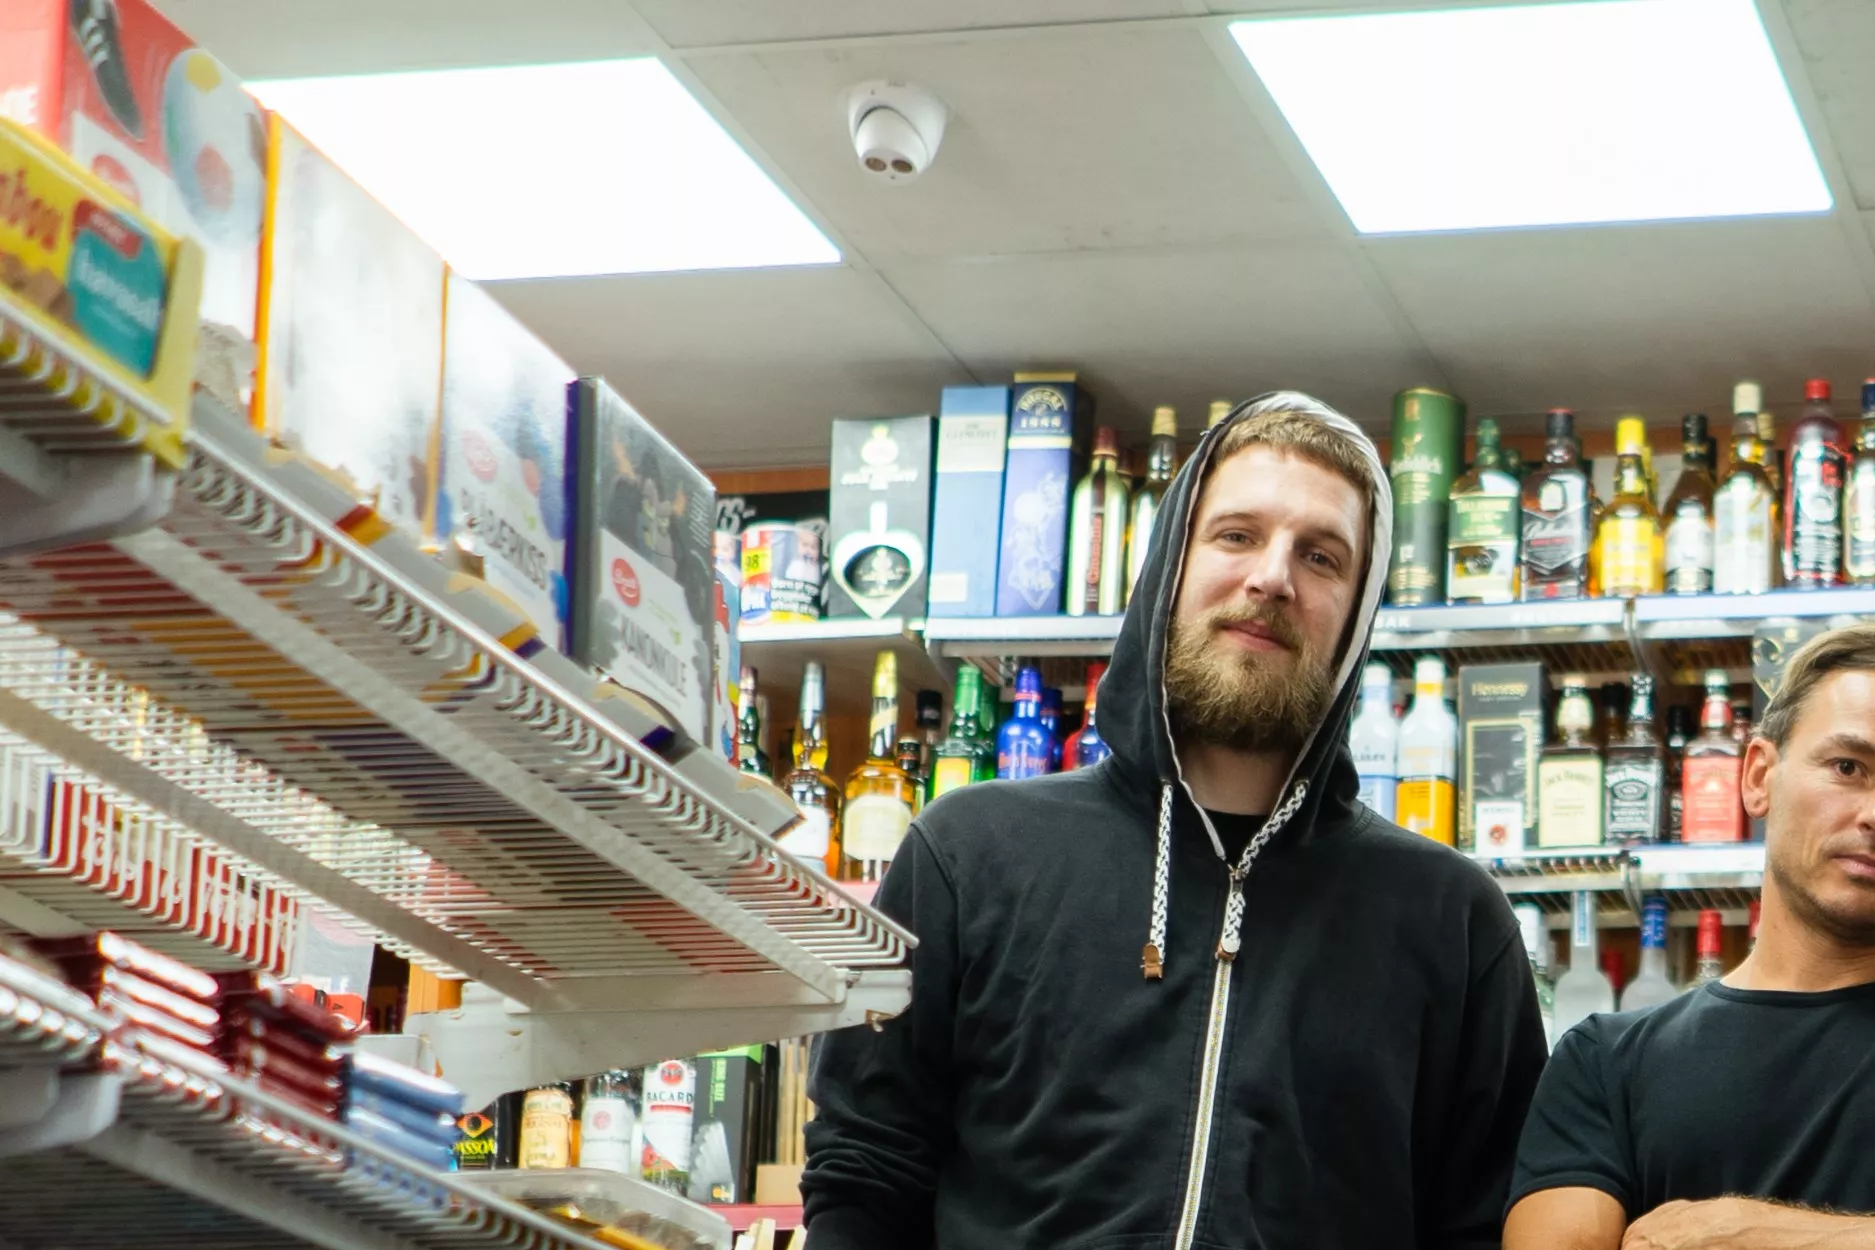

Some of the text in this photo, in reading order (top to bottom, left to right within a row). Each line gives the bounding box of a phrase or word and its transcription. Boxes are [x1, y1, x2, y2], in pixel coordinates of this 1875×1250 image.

[1374, 614, 1412, 629] BAK
[1472, 682, 1528, 697] Hennessy
[646, 1090, 695, 1104] BACARD
